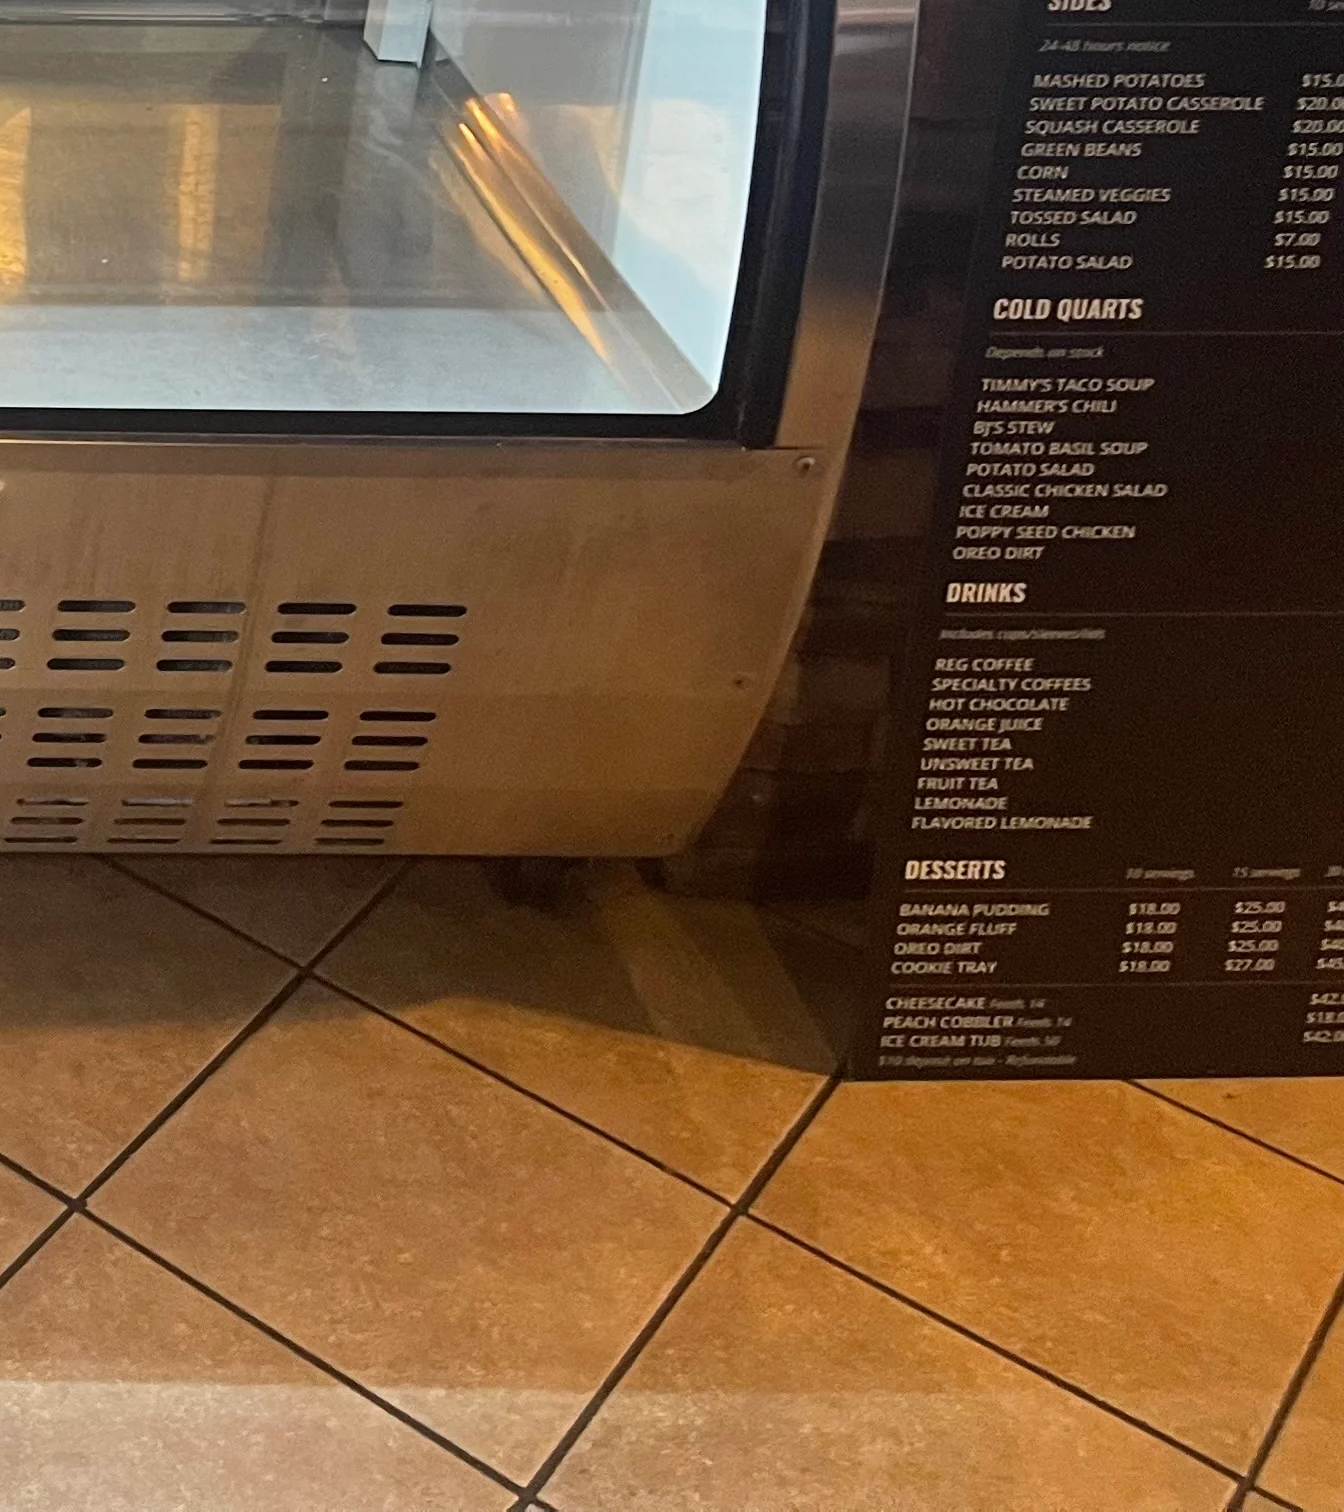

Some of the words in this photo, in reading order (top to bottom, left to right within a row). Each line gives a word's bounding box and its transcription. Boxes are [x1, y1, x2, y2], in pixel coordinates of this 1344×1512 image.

[1033, 73, 1110, 88] MASHED
[1113, 73, 1206, 88] POTATOES
[1029, 97, 1086, 112] SWEET
[1090, 97, 1163, 112] POTATO
[1166, 97, 1265, 112] CASSEROLE
[1024, 120, 1098, 135] SQUASH
[1103, 120, 1201, 135] CASSEROLE
[1021, 143, 1081, 157] GREEN
[1084, 143, 1142, 157] BEANS
[1287, 143, 1343, 157] $15.00
[1017, 166, 1069, 179] CORN
[1283, 166, 1339, 179] $15.00
[1012, 189, 1094, 202] STEAMED
[1099, 189, 1172, 202] VEGGIES
[1277, 189, 1335, 202] $15.00
[1011, 211, 1077, 225] TOSSED
[1079, 211, 1137, 225] SALAD
[1274, 211, 1331, 225] $15.00
[1005, 233, 1061, 247] ROLLS
[1274, 233, 1321, 247] $7.00
[1001, 256, 1073, 269] POTATO
[1076, 256, 1134, 269] SALAD
[1263, 256, 1321, 269] $15.00
[993, 298, 1051, 321] COLD
[1057, 298, 1144, 321] QUARTS
[1057, 379, 1103, 392] TACO
[1106, 379, 1155, 392] SOUP
[1071, 400, 1117, 413] CHILI
[1006, 421, 1056, 436] STEW
[970, 442, 1045, 455] TOMATO
[1049, 442, 1095, 455] BASIL
[1099, 442, 1149, 455] SOUP
[966, 463, 1037, 476] POTATO
[1039, 463, 1095, 476] SALAD
[963, 484, 1030, 498] CLASSIC
[1034, 484, 1110, 498] CHICKEN
[1113, 484, 1169, 498] SALAD
[959, 505, 986, 518] ICE
[989, 505, 1050, 518] CREAM
[956, 526, 1014, 538] POPPY
[1015, 526, 1058, 538] SEED
[1062, 526, 1136, 538] CHICKEN
[952, 546, 1001, 560] OREO
[1004, 546, 1045, 560] DIRT
[946, 583, 1027, 603] DRINKS
[935, 658, 969, 671] REG
[972, 658, 1035, 671] COFFEE
[931, 678, 1019, 691] SPECIALTY
[1021, 678, 1092, 691] COFFEES
[929, 698, 966, 711] HOT
[969, 698, 1070, 711] CHOCOLATE
[926, 718, 997, 731] ORANGE
[998, 718, 1044, 734] JUICE
[922, 738, 978, 751] SWEET
[981, 738, 1012, 751] TEA
[920, 758, 1001, 771] UNSWEET
[1004, 758, 1034, 771] TEA
[917, 777, 966, 790] FRUIT
[969, 777, 999, 790] TEA
[914, 797, 1009, 810] LEMONADE
[912, 816, 996, 830] FLAVORED
[1000, 816, 1094, 830] LEMONADE
[905, 860, 1007, 880] DESSERTS
[899, 904, 970, 916] BANANA
[972, 904, 1050, 916] PUDDING
[896, 923, 966, 936] ORANGE
[969, 923, 1017, 936] FLUFF
[894, 943, 941, 955] OREO
[943, 942, 983, 955] DIRT
[891, 962, 953, 974] COOKIE
[957, 961, 997, 973] TRAY
[885, 998, 986, 1010] CHEESECAKE
[883, 1016, 937, 1028] PEACH
[940, 1016, 1014, 1028] COBBLER
[880, 1036, 905, 1047] ICE
[909, 1036, 966, 1047] CREAM
[969, 1035, 1001, 1047] TUB
